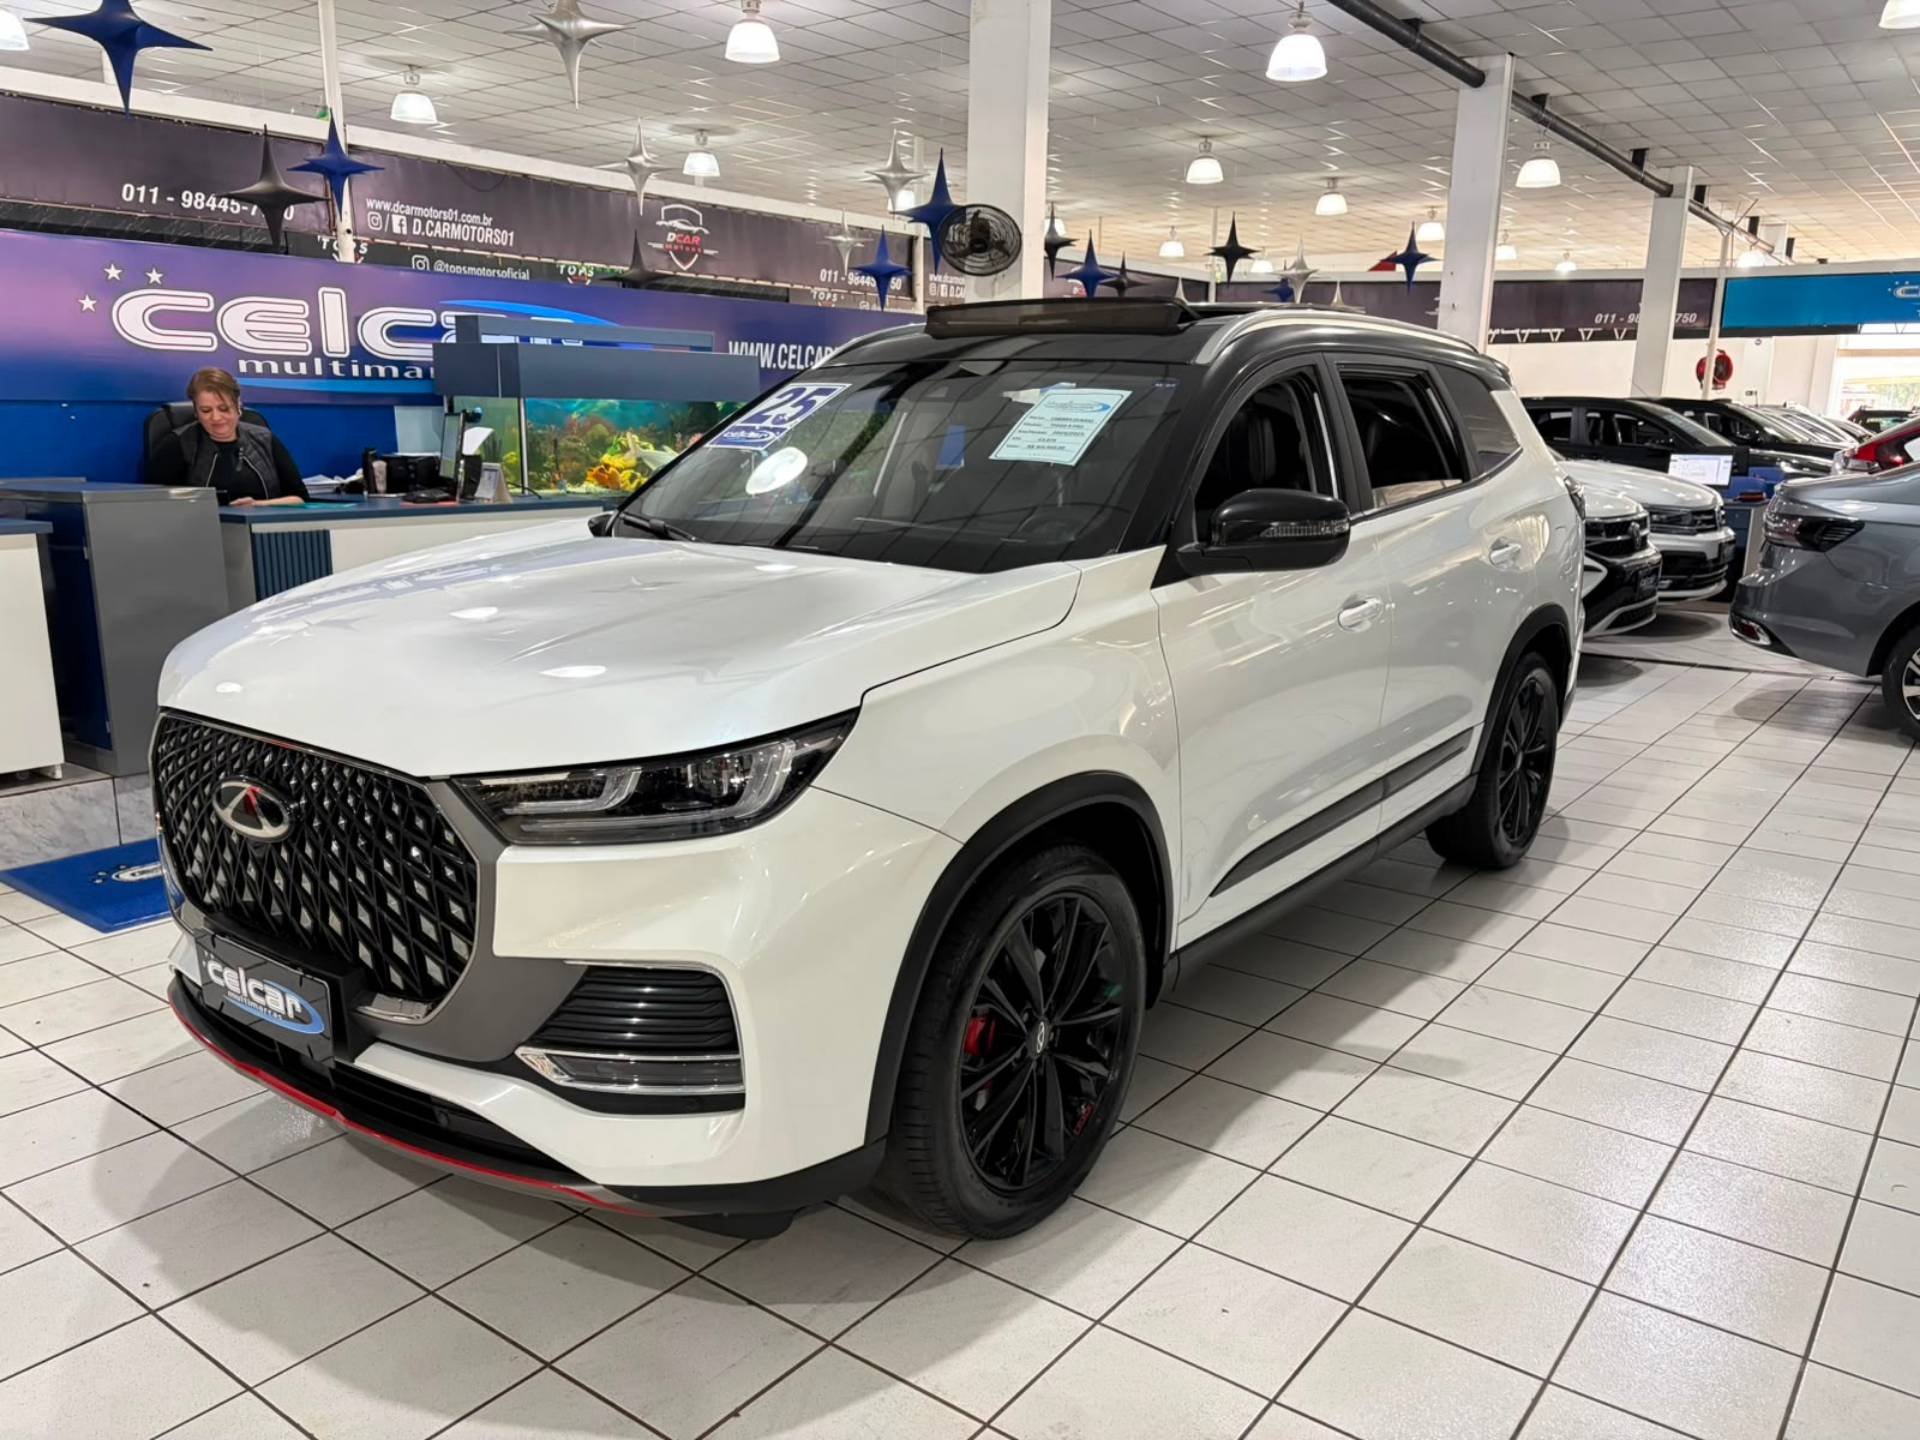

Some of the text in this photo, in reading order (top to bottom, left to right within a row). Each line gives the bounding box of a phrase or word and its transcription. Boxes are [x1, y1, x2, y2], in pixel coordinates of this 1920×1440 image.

[121, 183, 159, 204] 011
[181, 190, 295, 221] 98445-70
[366, 198, 493, 226] www.dcarmotors01.com.br
[412, 220, 515, 247] D.CARMOTORS01
[820, 268, 838, 283] 011
[1595, 313, 1616, 324] 011
[238, 357, 435, 379] multima
[740, 387, 840, 426] 25
[207, 960, 302, 1019] celcar
